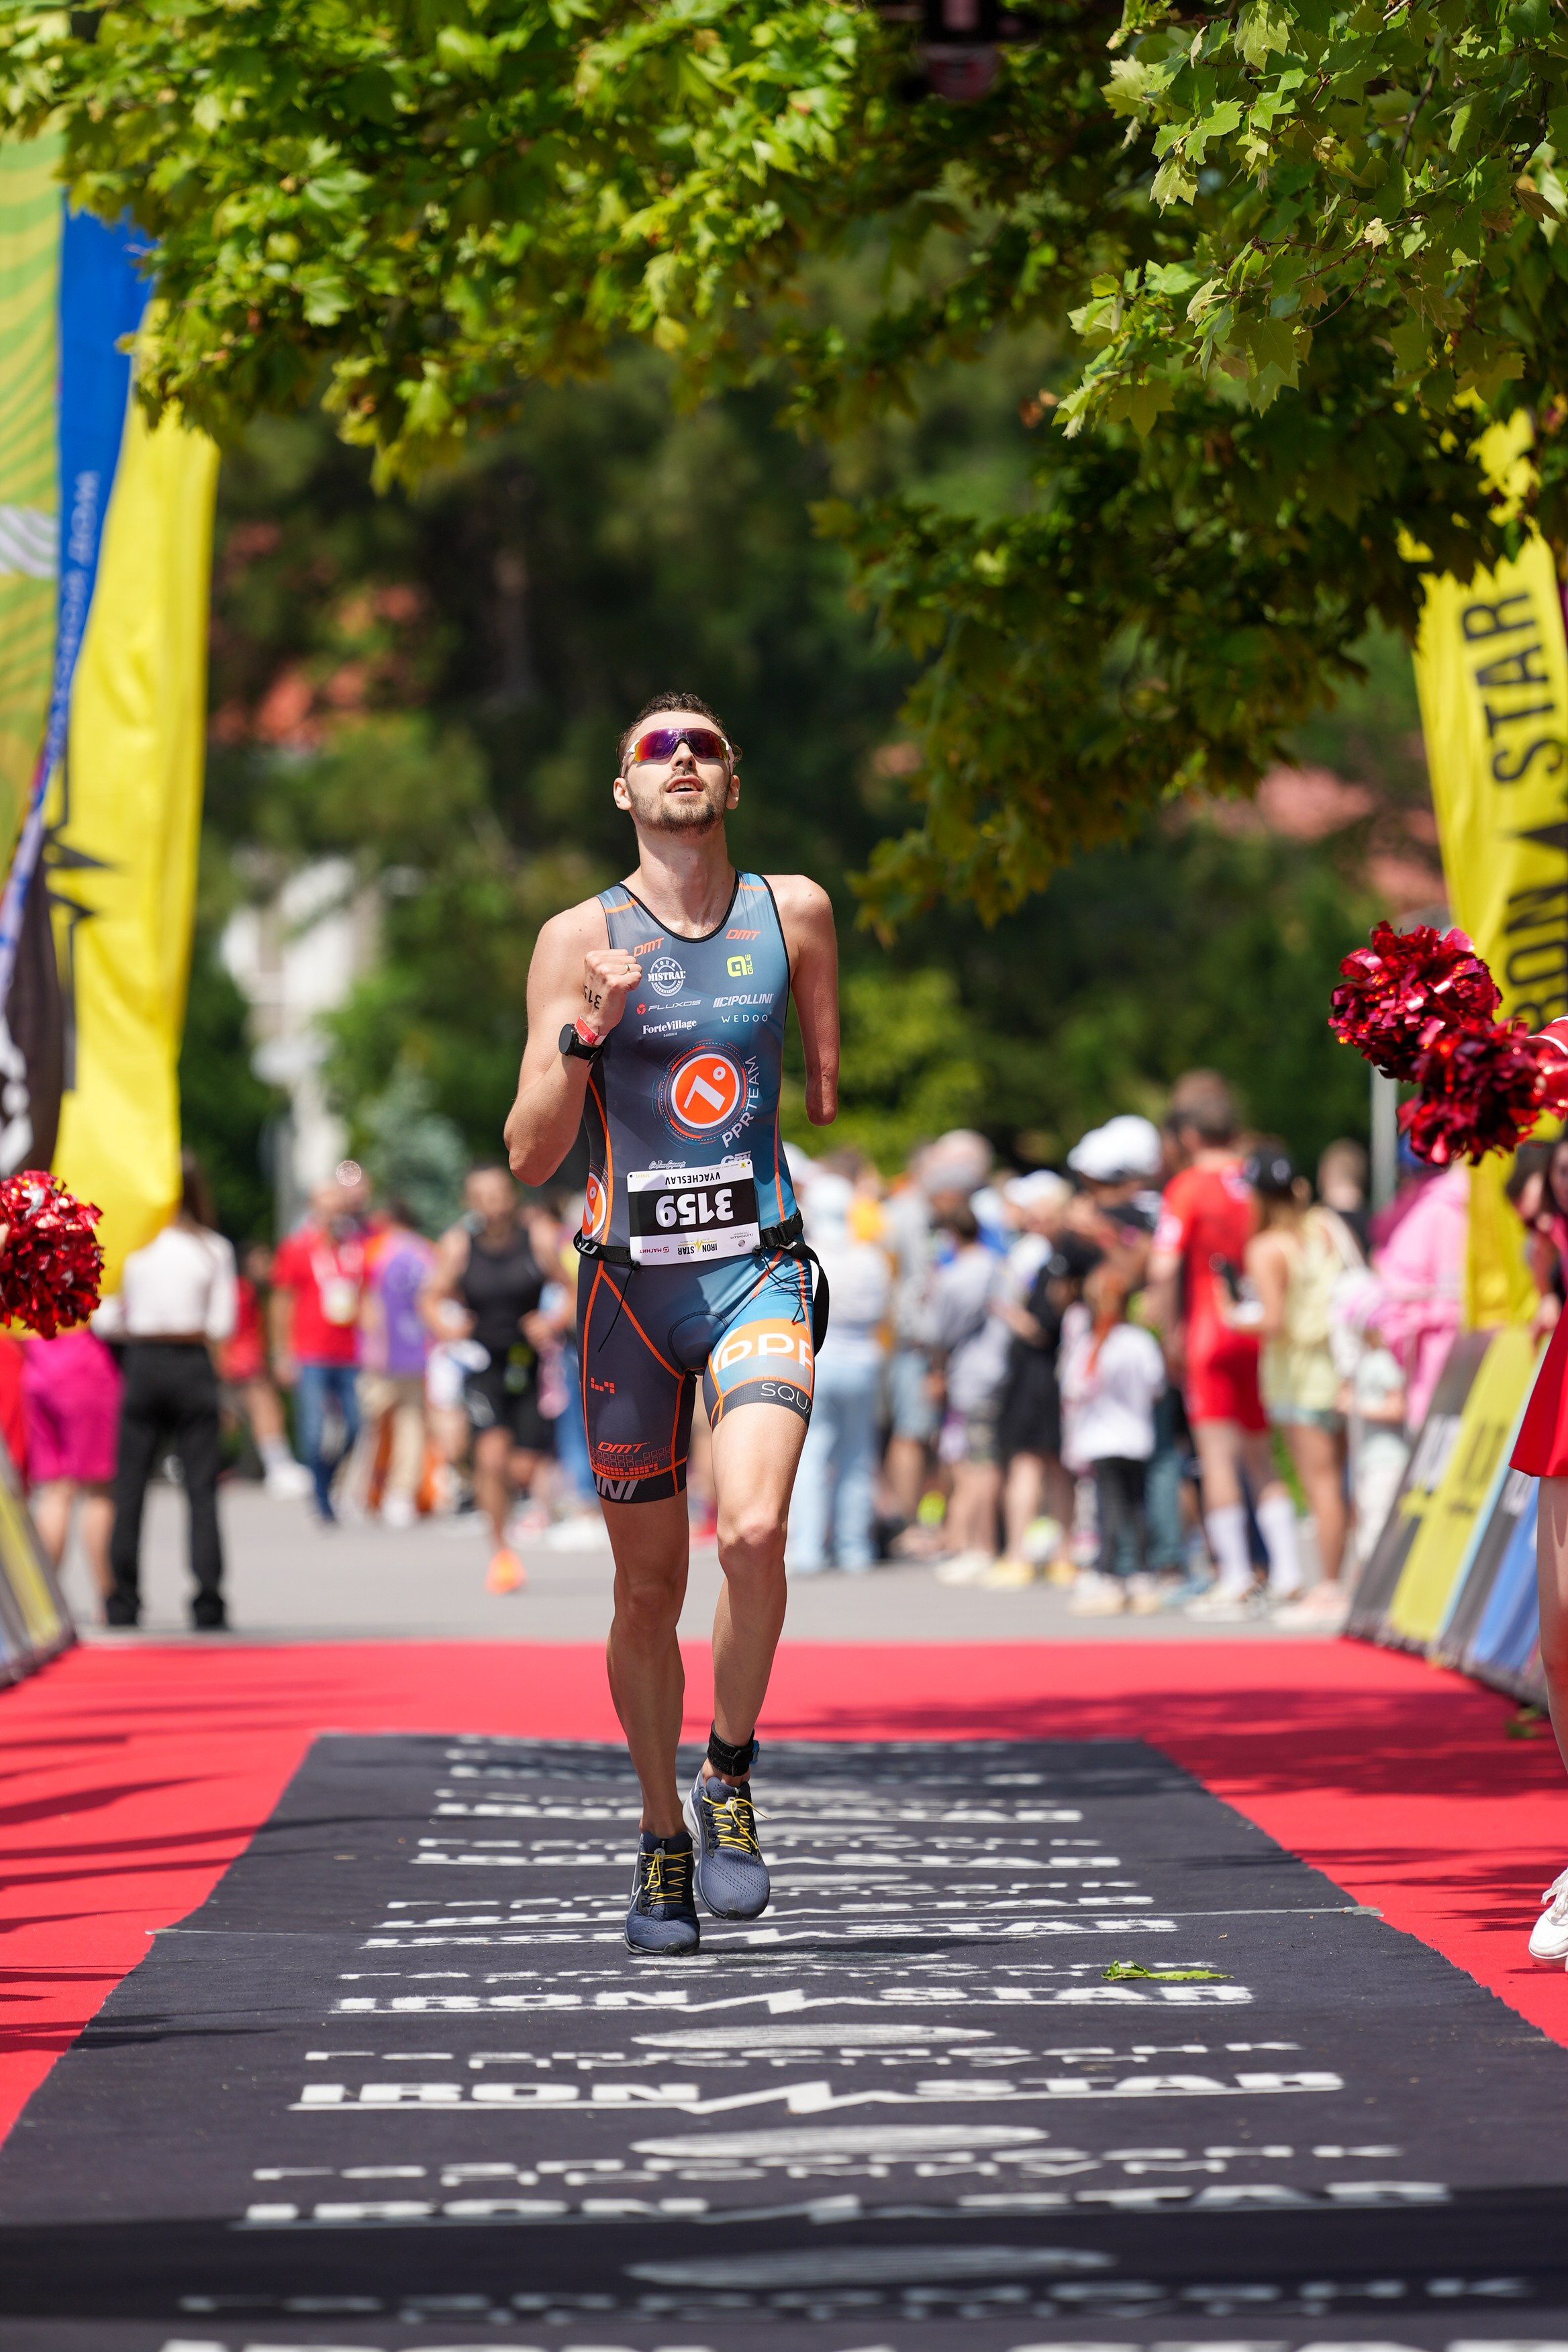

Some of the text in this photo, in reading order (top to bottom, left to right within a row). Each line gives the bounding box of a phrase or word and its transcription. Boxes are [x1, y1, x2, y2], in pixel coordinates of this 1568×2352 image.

[1461, 593, 1565, 784] STAR
[726, 928, 762, 940] DMT
[633, 937, 665, 957] DMT
[654, 960, 676, 969] TOUR
[647, 971, 686, 982] MISTRAL
[648, 999, 701, 1012] FLUXOS
[721, 1014, 768, 1024] WEDOO
[665, 1171, 721, 1185] VYACHESLAV
[655, 1188, 734, 1228] 3159
[639, 1246, 662, 1255] МАГНИТ
[677, 1242, 718, 1255] IRON STAR
[597, 1441, 648, 1454] DMT
[845, 1919, 1181, 1934] STAR
[336, 1986, 1253, 2010] IRON STAR
[301, 2071, 1345, 2103] IRON STAR
[243, 2181, 1450, 2224] IRON STAR
